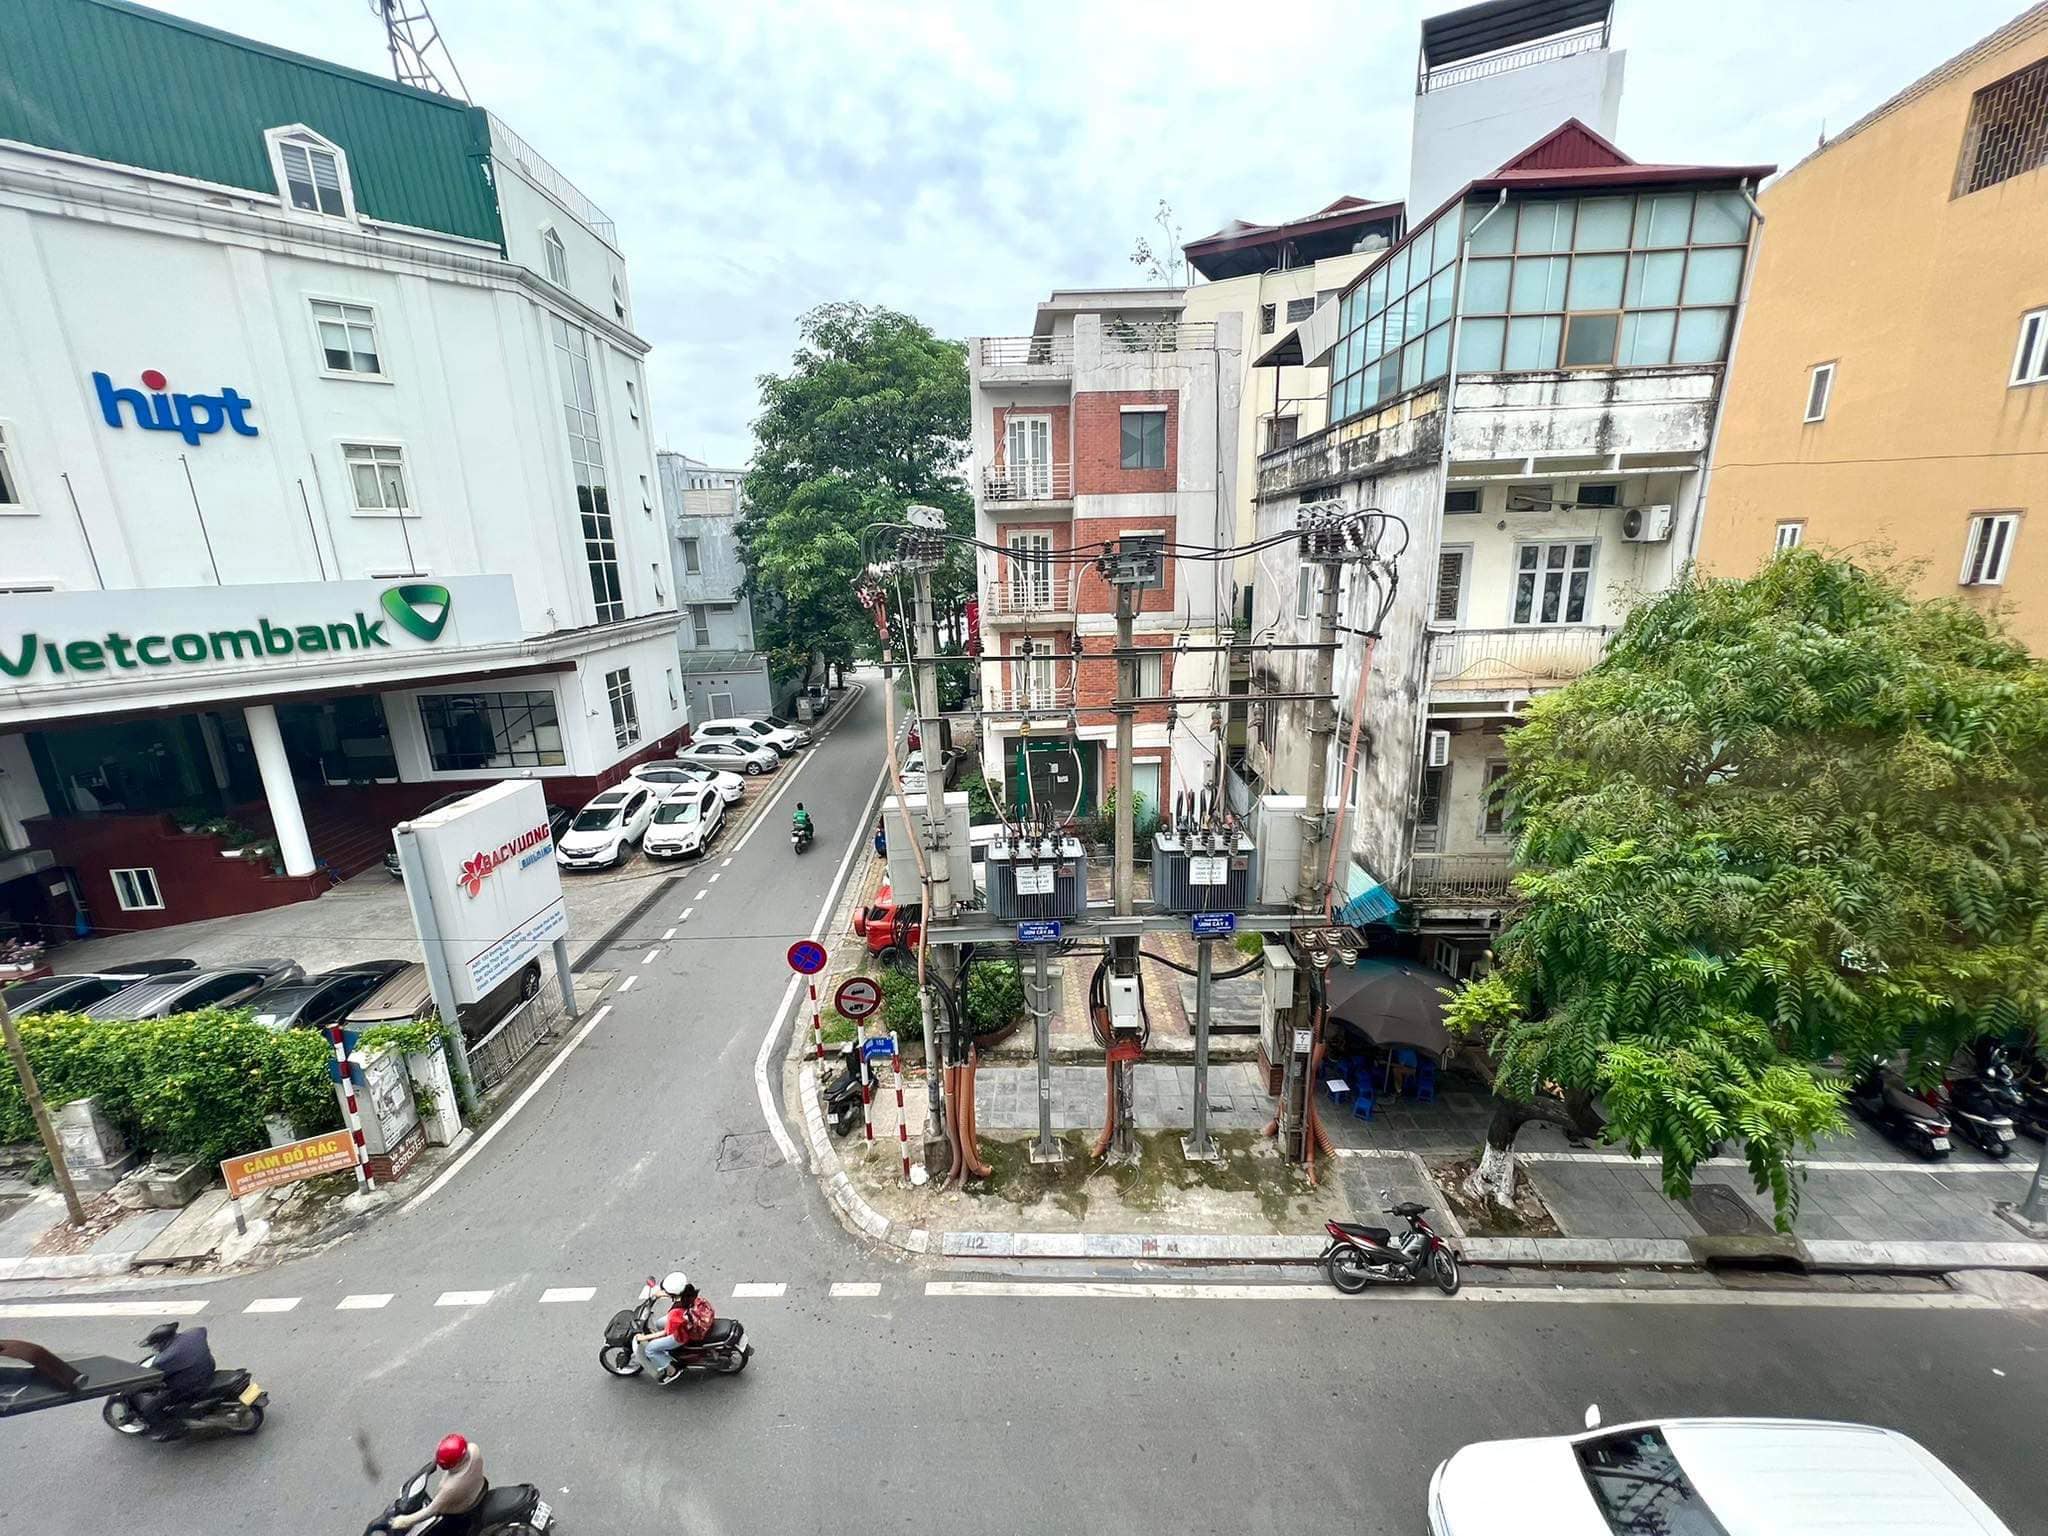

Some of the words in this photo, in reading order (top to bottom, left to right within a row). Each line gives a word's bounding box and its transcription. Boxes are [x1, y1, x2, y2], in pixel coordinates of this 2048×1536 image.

[92, 369, 259, 446] hipt
[0, 612, 391, 677] Vietcombank
[306, 1140, 338, 1158] RÁC
